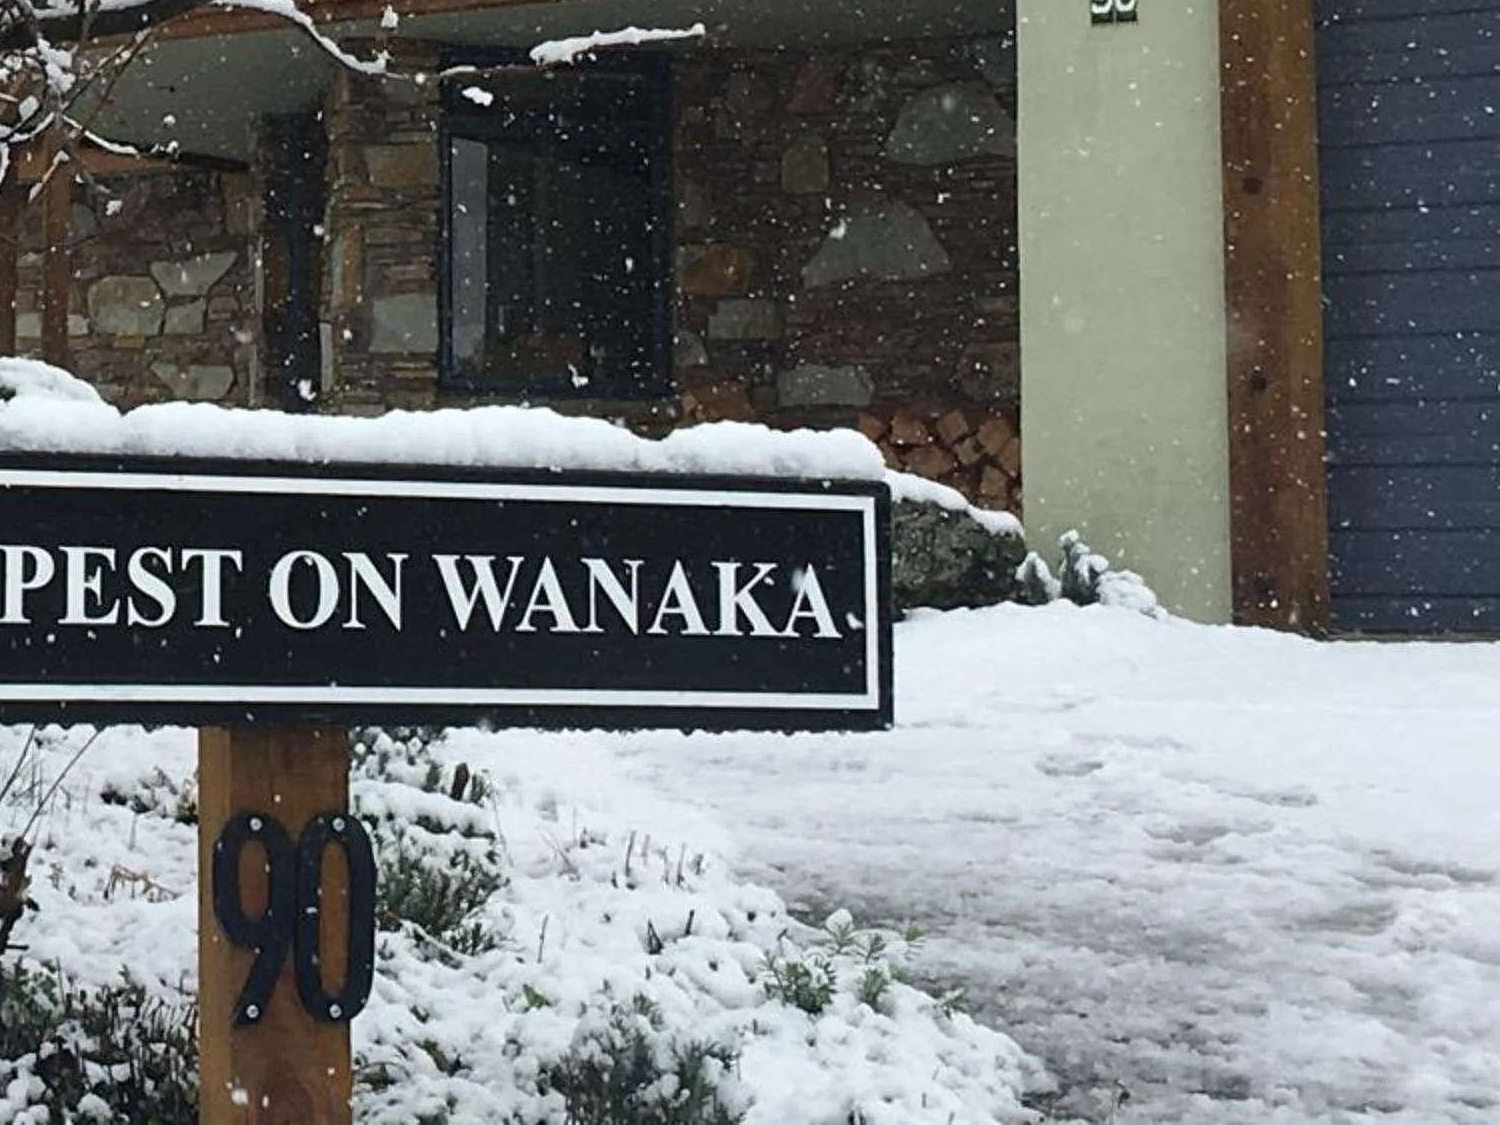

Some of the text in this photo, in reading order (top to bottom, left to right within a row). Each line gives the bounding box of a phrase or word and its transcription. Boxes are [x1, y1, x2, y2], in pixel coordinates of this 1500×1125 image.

[268, 550, 409, 631] ON
[431, 553, 844, 638] WANAKA
[212, 811, 377, 1029] 90
